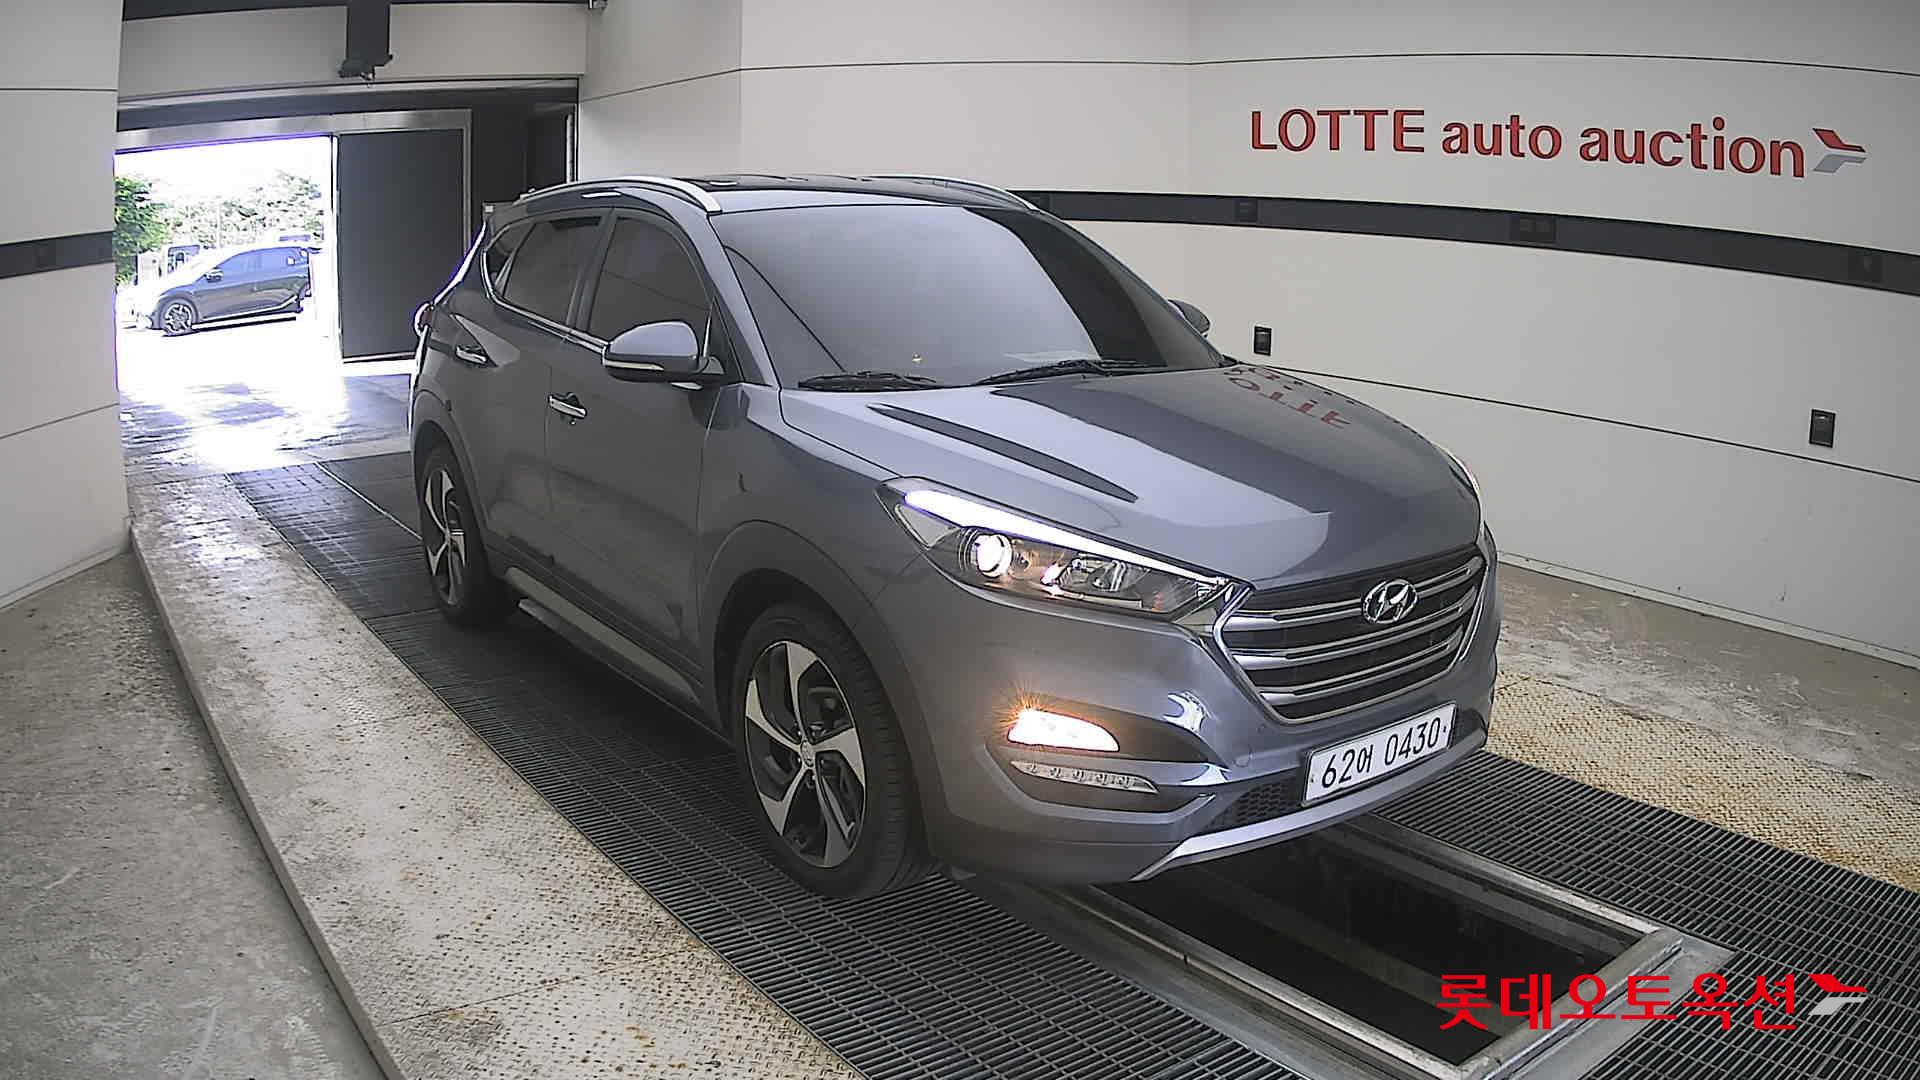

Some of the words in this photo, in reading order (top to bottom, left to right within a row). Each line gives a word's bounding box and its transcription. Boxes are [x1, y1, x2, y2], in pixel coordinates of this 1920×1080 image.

[1251, 110, 1424, 152] LOTTE
[1441, 115, 1562, 160] auto
[1579, 117, 1805, 178] auction
[1321, 744, 1374, 788] 62어
[1384, 717, 1441, 766] 0430
